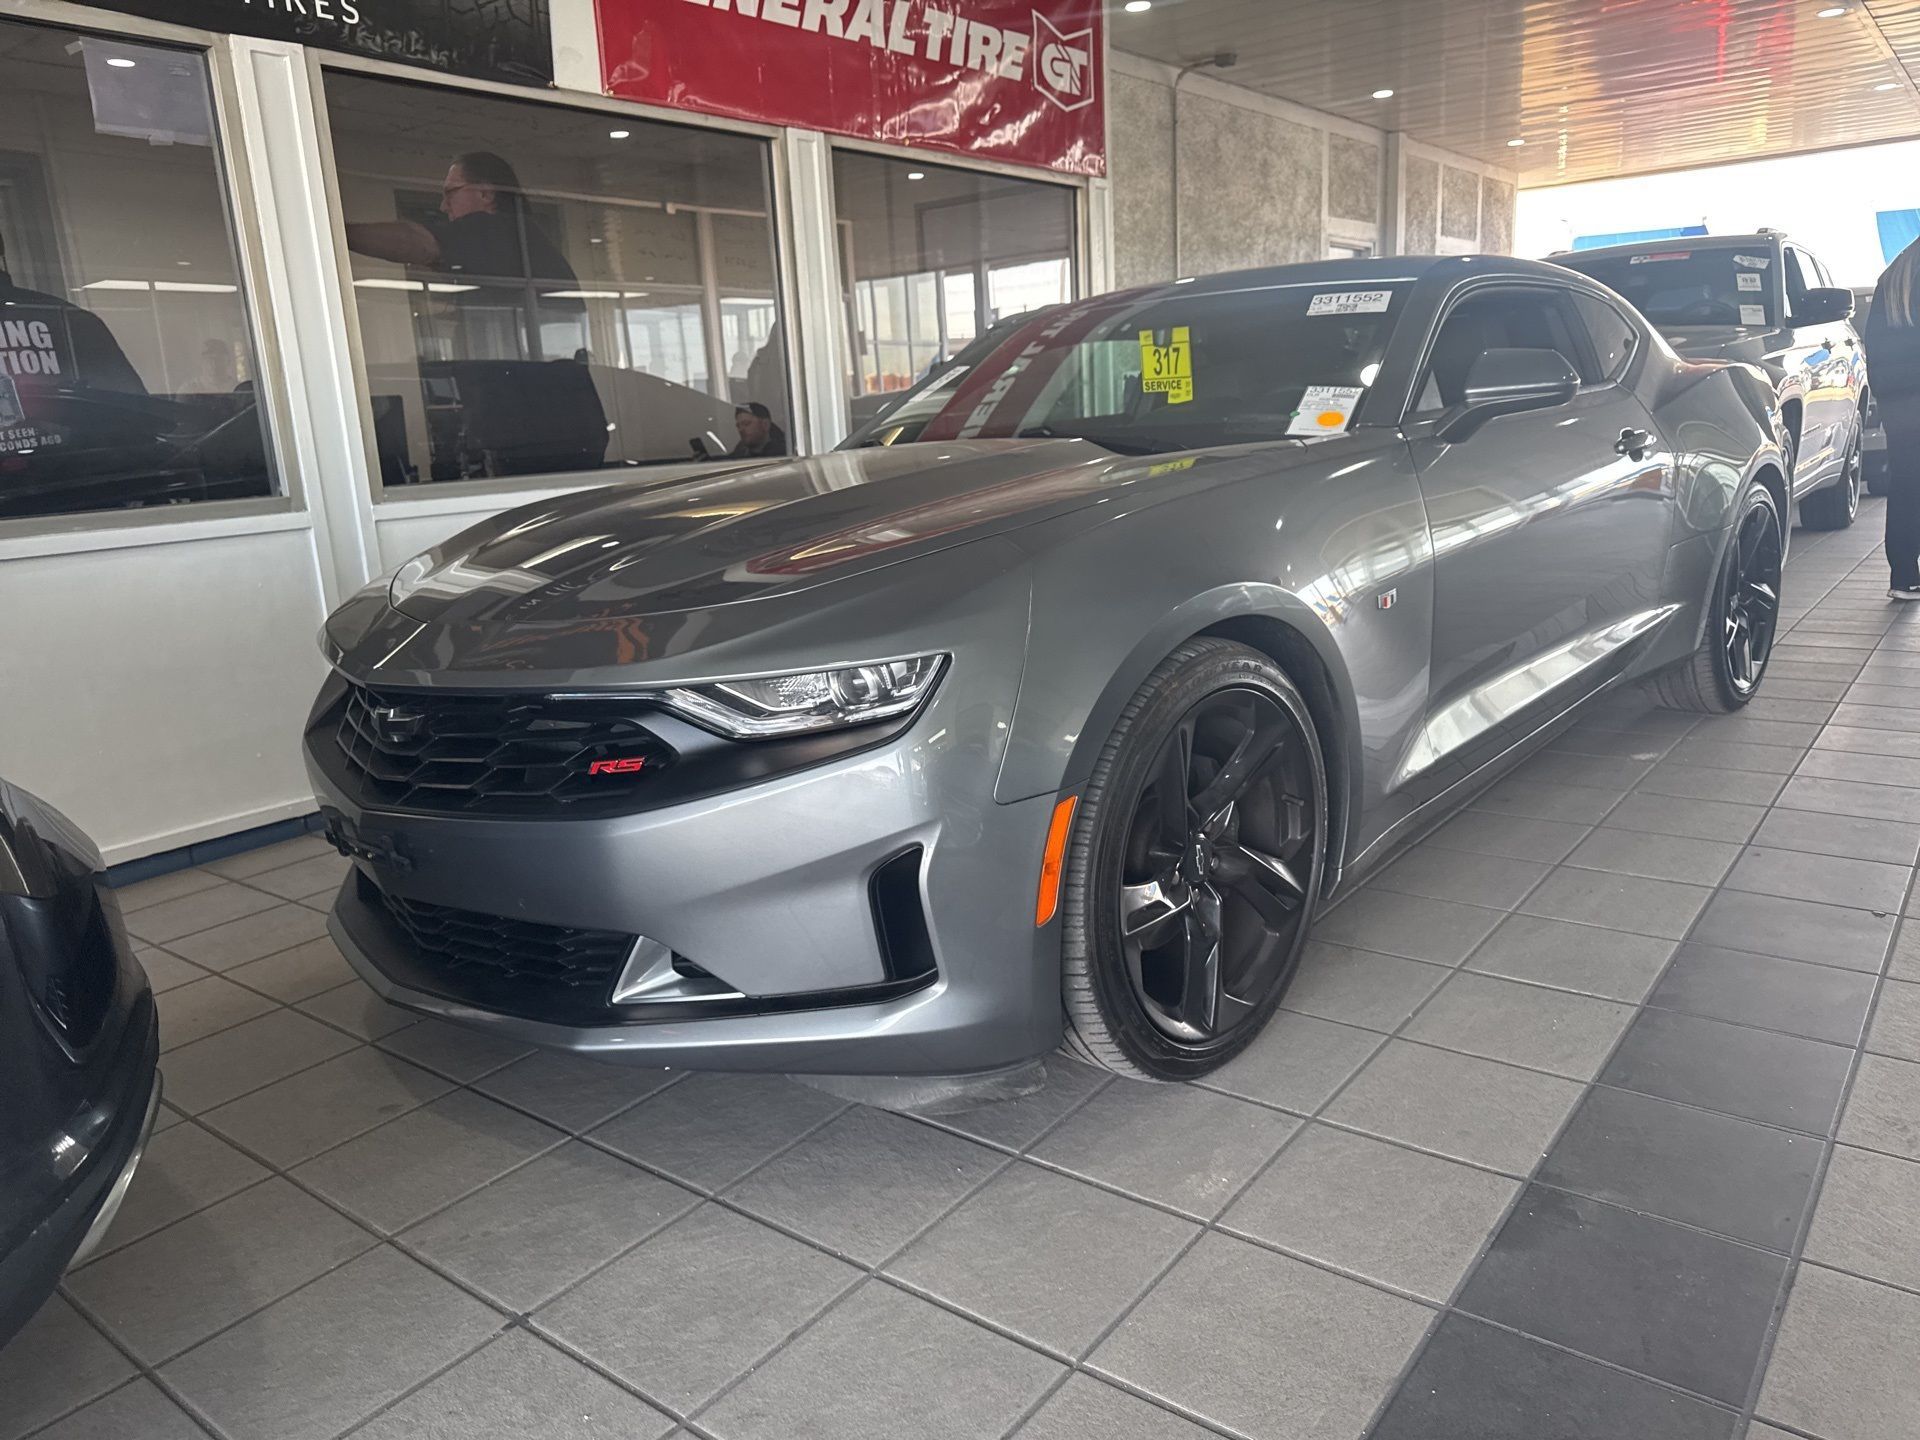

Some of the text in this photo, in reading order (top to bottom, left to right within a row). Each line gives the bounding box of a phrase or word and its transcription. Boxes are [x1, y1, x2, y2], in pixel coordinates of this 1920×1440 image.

[1041, 43, 1088, 96] GT
[1312, 293, 1384, 306] 3311552
[1152, 345, 1180, 376] 317
[1144, 380, 1182, 391] SERVICE
[588, 757, 645, 775] RS
